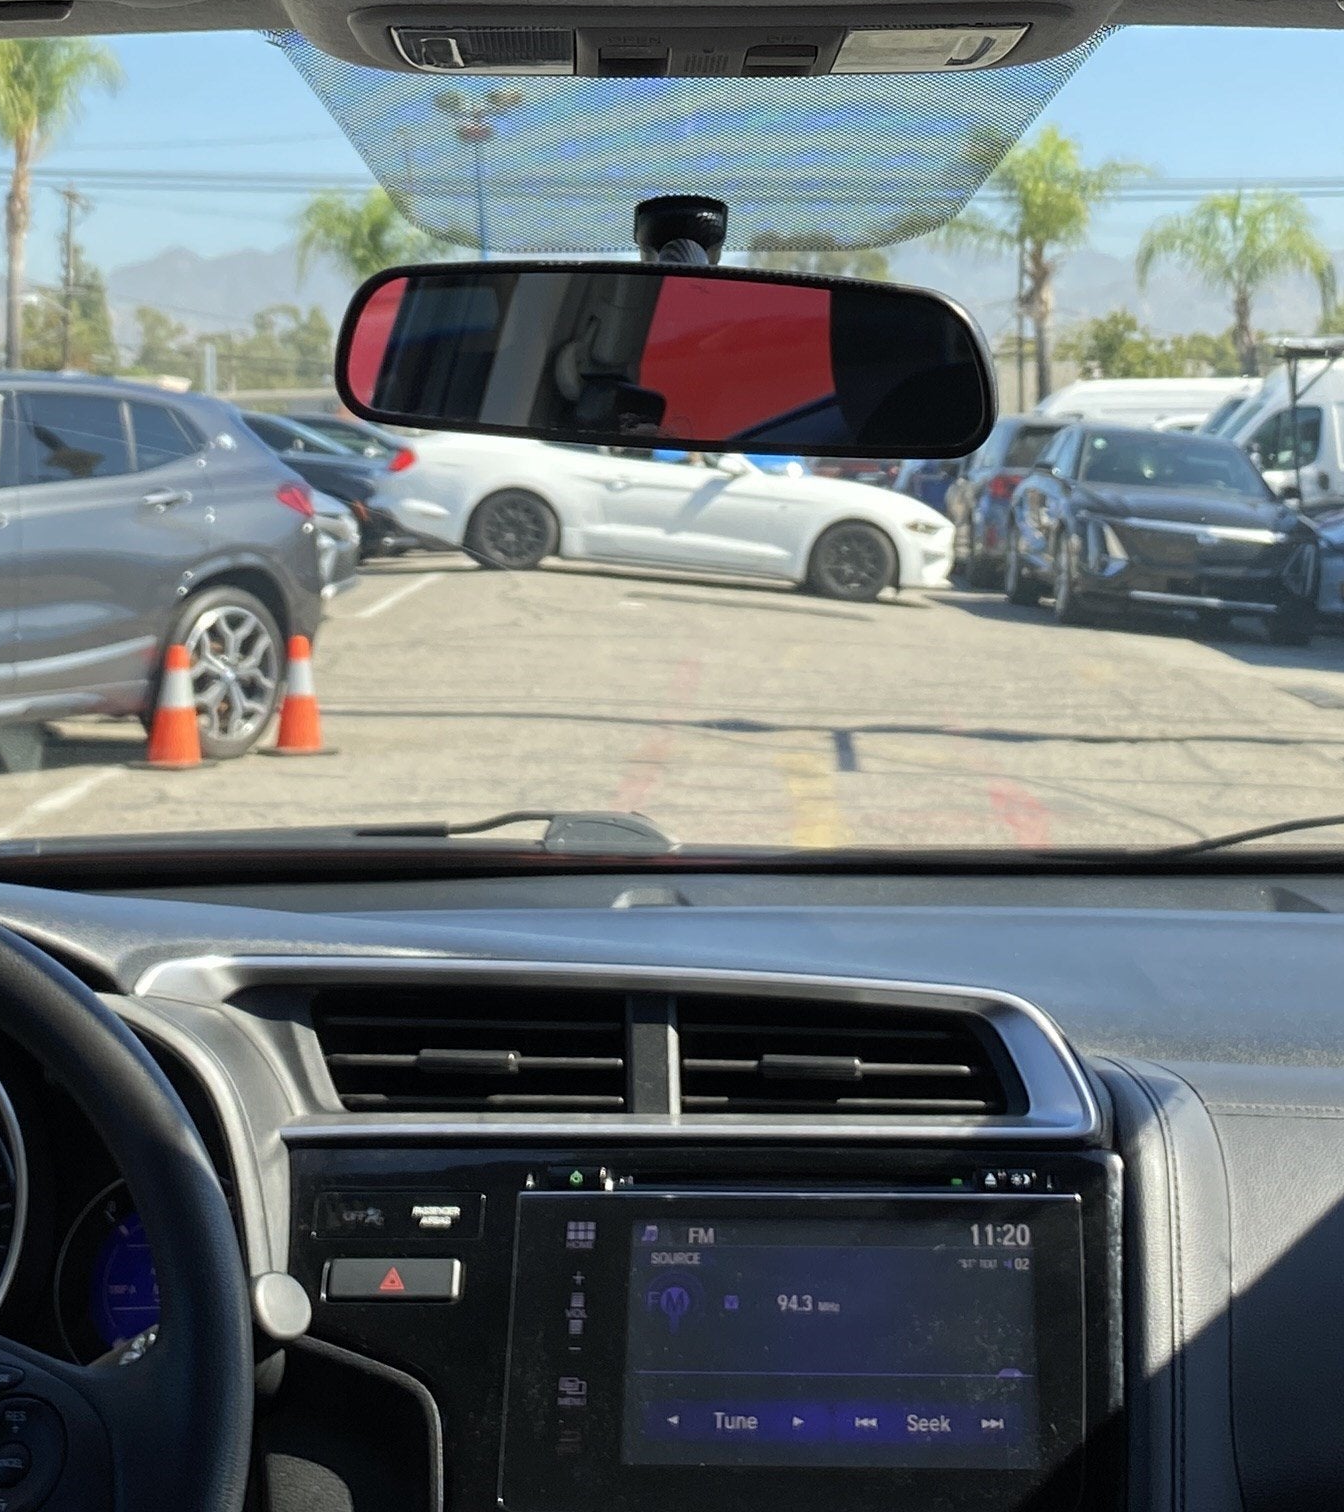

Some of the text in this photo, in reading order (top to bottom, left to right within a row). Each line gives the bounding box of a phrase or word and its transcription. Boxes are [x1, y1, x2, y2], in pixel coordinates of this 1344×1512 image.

[688, 1228, 715, 1244] FM
[970, 1223, 1030, 1246] 11:20
[651, 1252, 701, 1266] SOURCE
[1014, 1258, 1030, 1271] 02
[777, 1294, 813, 1312] 94.3
[5, 1410, 27, 1422] RES
[713, 1410, 758, 1432] Tune
[906, 1411, 951, 1433] Seek
